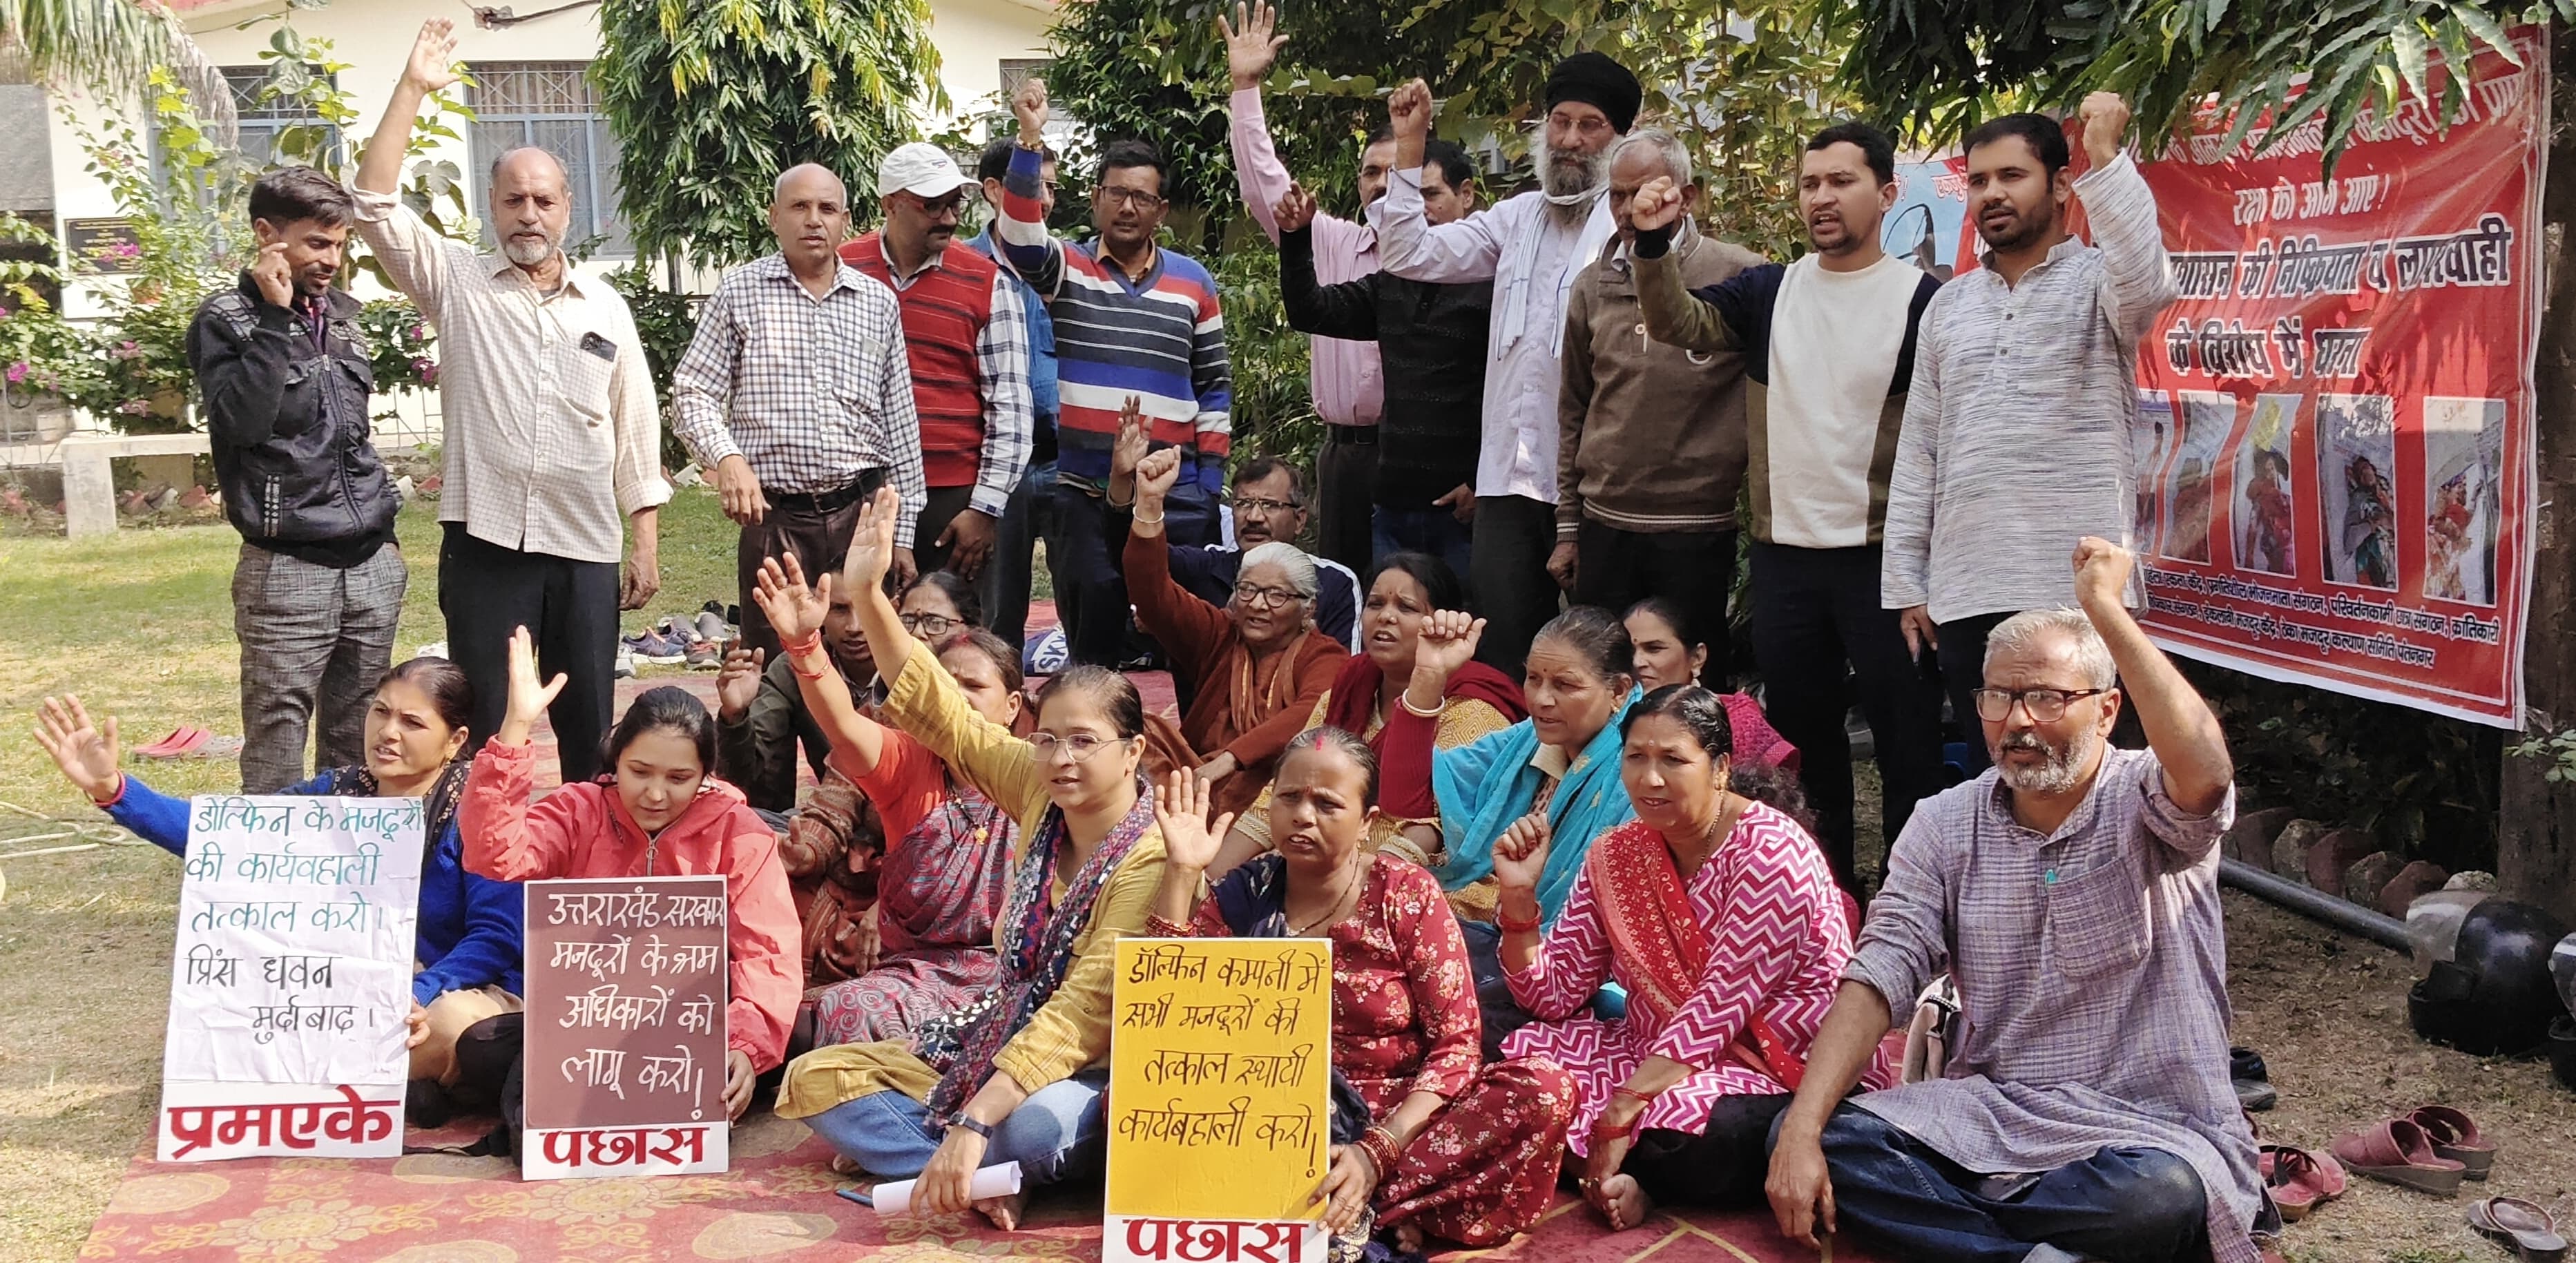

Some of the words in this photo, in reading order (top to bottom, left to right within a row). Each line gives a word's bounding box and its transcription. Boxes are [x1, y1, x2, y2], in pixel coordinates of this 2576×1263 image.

[2233, 188, 2267, 228] रक्षा
[2271, 176, 2296, 220] को
[2238, 238, 2274, 299] की
[2367, 239, 2391, 293] व
[2165, 318, 2194, 376] के
[2198, 318, 2274, 378] विरोध
[2272, 316, 2303, 379] में
[2314, 328, 2372, 378] धरना
[2329, 592, 2395, 626] परिवर्तनकामी
[2298, 624, 2332, 655] मजदूर
[2330, 631, 2367, 655] कल्याण
[2366, 631, 2396, 662] समिति
[2396, 637, 2436, 669] पंतनगर
[304, 799, 334, 833] के
[339, 799, 423, 842] मजदूरों
[186, 841, 227, 883] की
[191, 900, 302, 933] तत्काल
[547, 885, 661, 929] उत्तराखंड
[662, 896, 724, 928] सरकार
[183, 943, 244, 987] प्रिंस
[259, 954, 343, 990] धवन
[550, 933, 632, 983] मजदूरों
[640, 934, 669, 977] के
[669, 945, 720, 975] श्रम
[1128, 944, 1209, 984] डॉल्फिन
[1217, 949, 1297, 992] कम्पनी
[1296, 952, 1328, 994] में
[558, 983, 675, 1031] अधिकारों
[677, 993, 716, 1036] को
[1122, 992, 1175, 1030] सभी
[1178, 994, 1260, 1037] मजदूरों
[1264, 996, 1302, 1036] की
[560, 1047, 626, 1100] लागू
[1144, 1048, 1233, 1087] तत्काल
[1234, 1043, 1314, 1089] स्थायी
[166, 1084, 402, 1160] प्रमएके
[1117, 1095, 1252, 1148] कार्यबहाली
[539, 1126, 710, 1168] पछास
[1122, 1217, 1310, 1263] पछास
